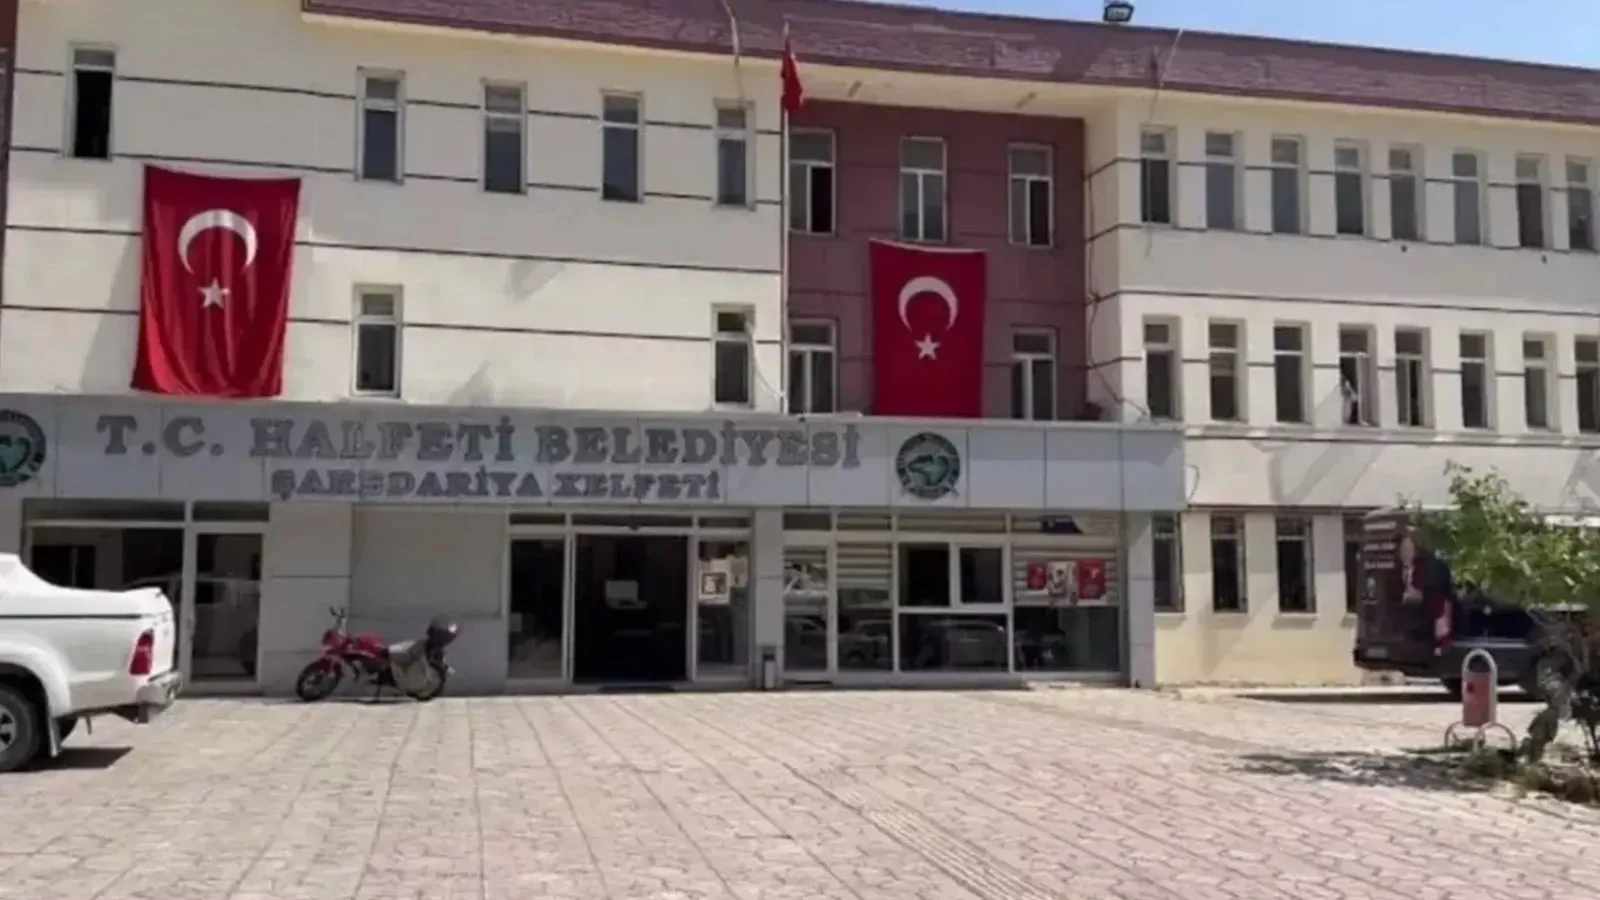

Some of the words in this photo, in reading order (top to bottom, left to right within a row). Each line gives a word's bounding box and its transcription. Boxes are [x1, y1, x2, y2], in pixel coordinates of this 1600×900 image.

[96, 415, 225, 457] T.C.
[249, 415, 515, 461] HALFETİ
[534, 419, 861, 469] BELEDİYESİ
